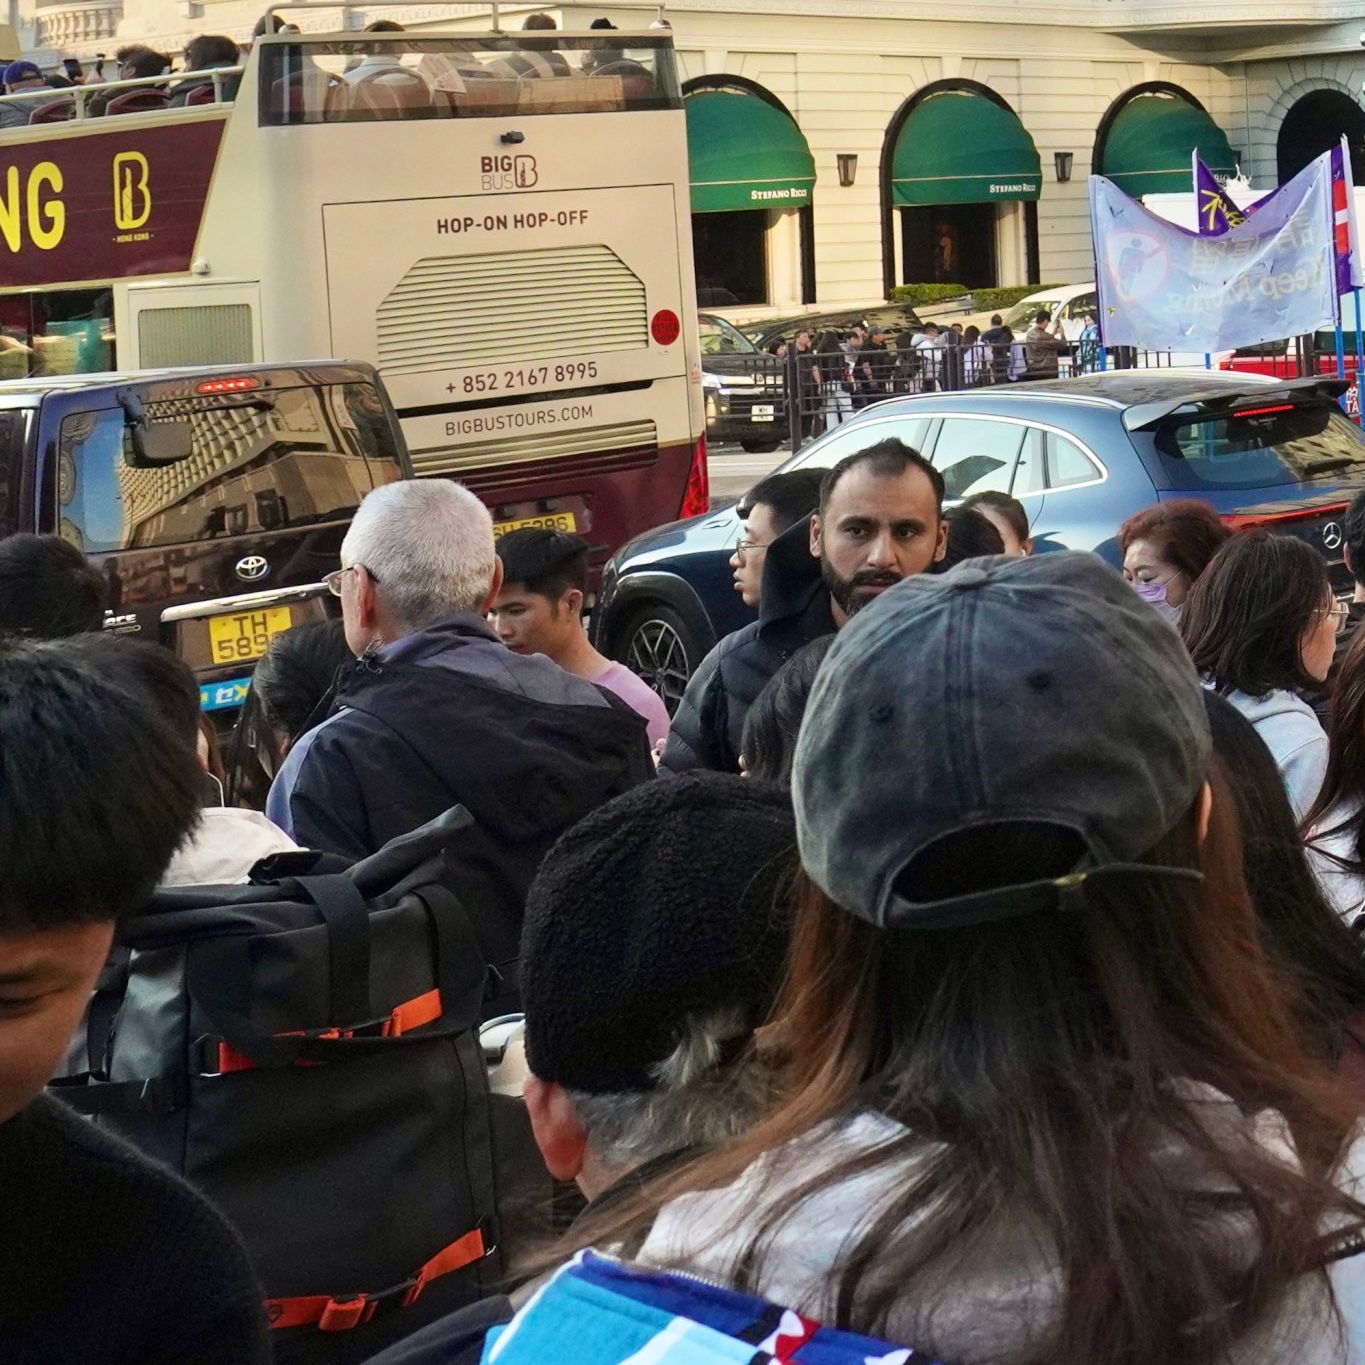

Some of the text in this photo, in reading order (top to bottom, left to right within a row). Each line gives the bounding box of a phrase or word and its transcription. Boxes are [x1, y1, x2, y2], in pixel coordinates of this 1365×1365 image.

[481, 155, 513, 173] BIG
[481, 173, 514, 191] BUS
[989, 184, 1022, 194] STEFANO
[750, 189, 789, 200] STEFANO
[437, 210, 589, 235] HOP-ON HOP-OFF
[463, 374, 498, 394] 852
[504, 367, 548, 389] 2167
[555, 361, 598, 383] 8995
[445, 405, 593, 437] BIGBUSTOURS.COM
[233, 613, 269, 637] TH
